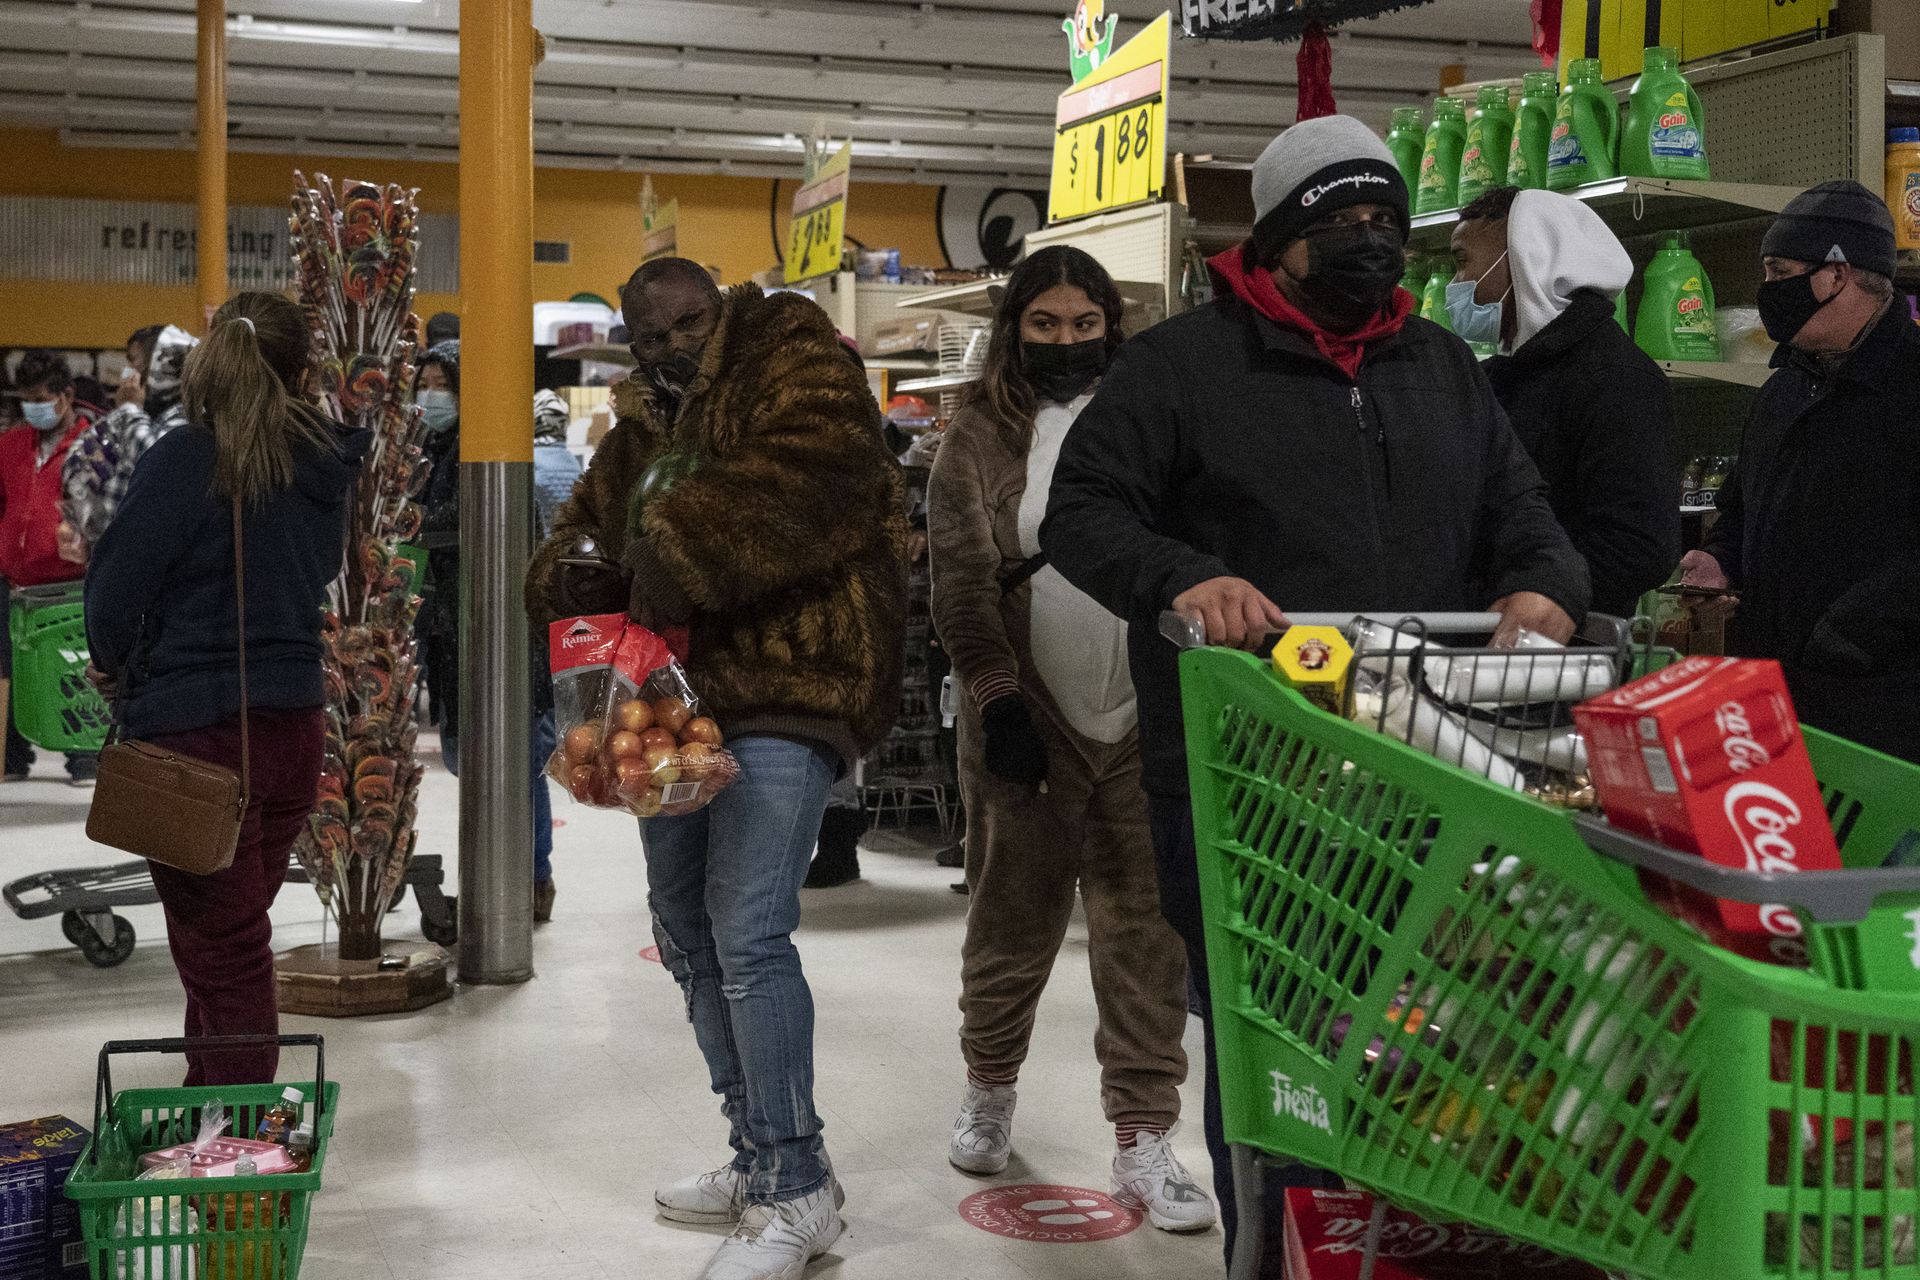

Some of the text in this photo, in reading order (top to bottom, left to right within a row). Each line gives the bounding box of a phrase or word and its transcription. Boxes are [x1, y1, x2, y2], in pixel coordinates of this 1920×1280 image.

[1659, 112, 1687, 129] Gain
[1301, 172, 1389, 206] Champion
[102, 222, 274, 259] refreing
[1677, 297, 1703, 314] Gain
[1685, 491, 1716, 506] snap
[562, 633, 602, 649] Rainier
[1268, 1068, 1331, 1131] Fiesta
[33, 1127, 83, 1147] Takis
[969, 1187, 1088, 1240] SOCIAL DISTANCING
